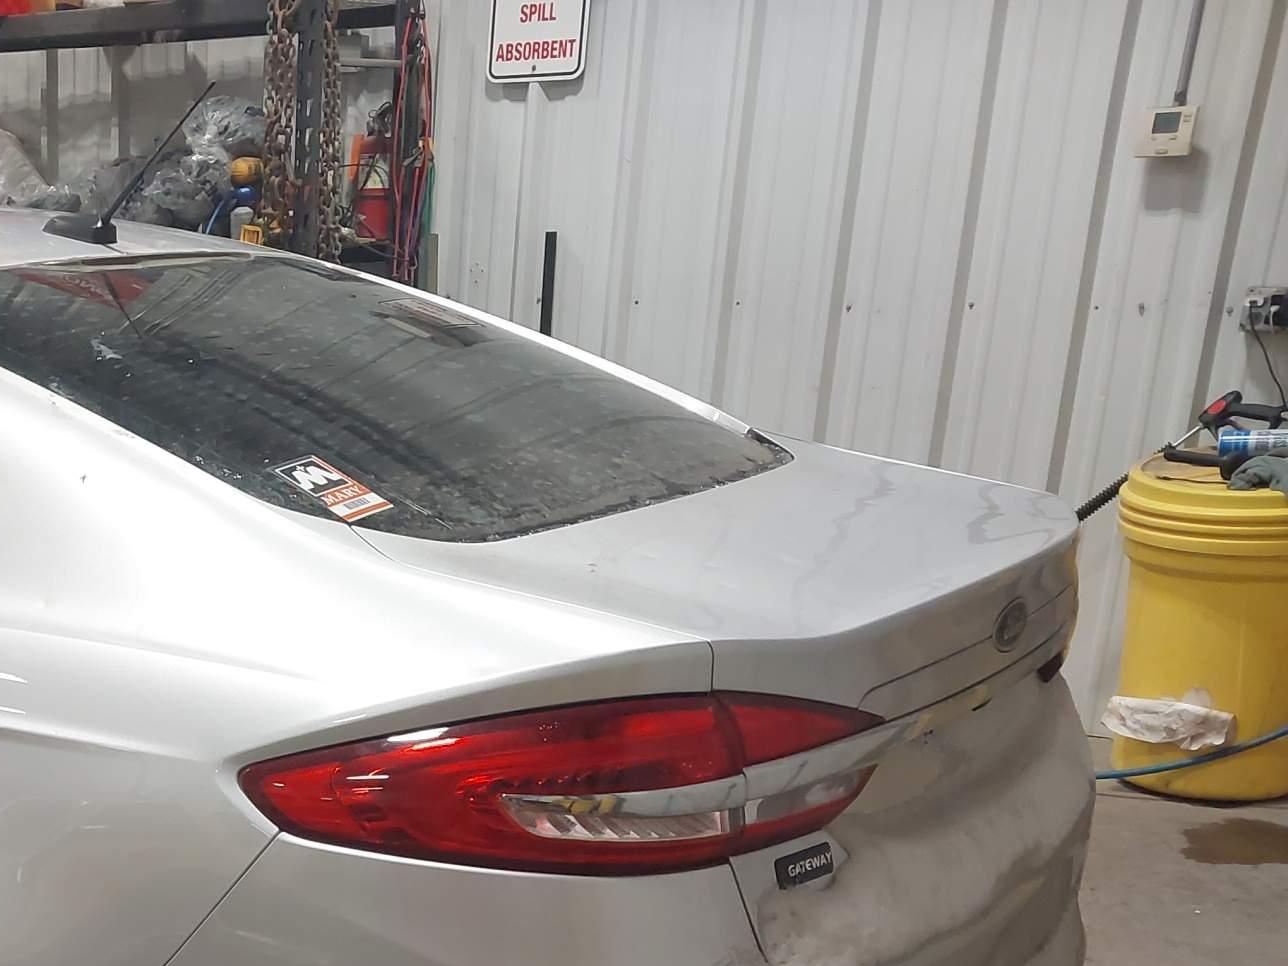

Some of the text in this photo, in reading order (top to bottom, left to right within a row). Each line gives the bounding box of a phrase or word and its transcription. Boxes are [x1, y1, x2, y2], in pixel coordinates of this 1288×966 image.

[520, 2, 557, 23] SPILL
[495, 39, 577, 62] ABSORBENT
[320, 485, 362, 506] MARY
[788, 852, 832, 877] GATEWAY
